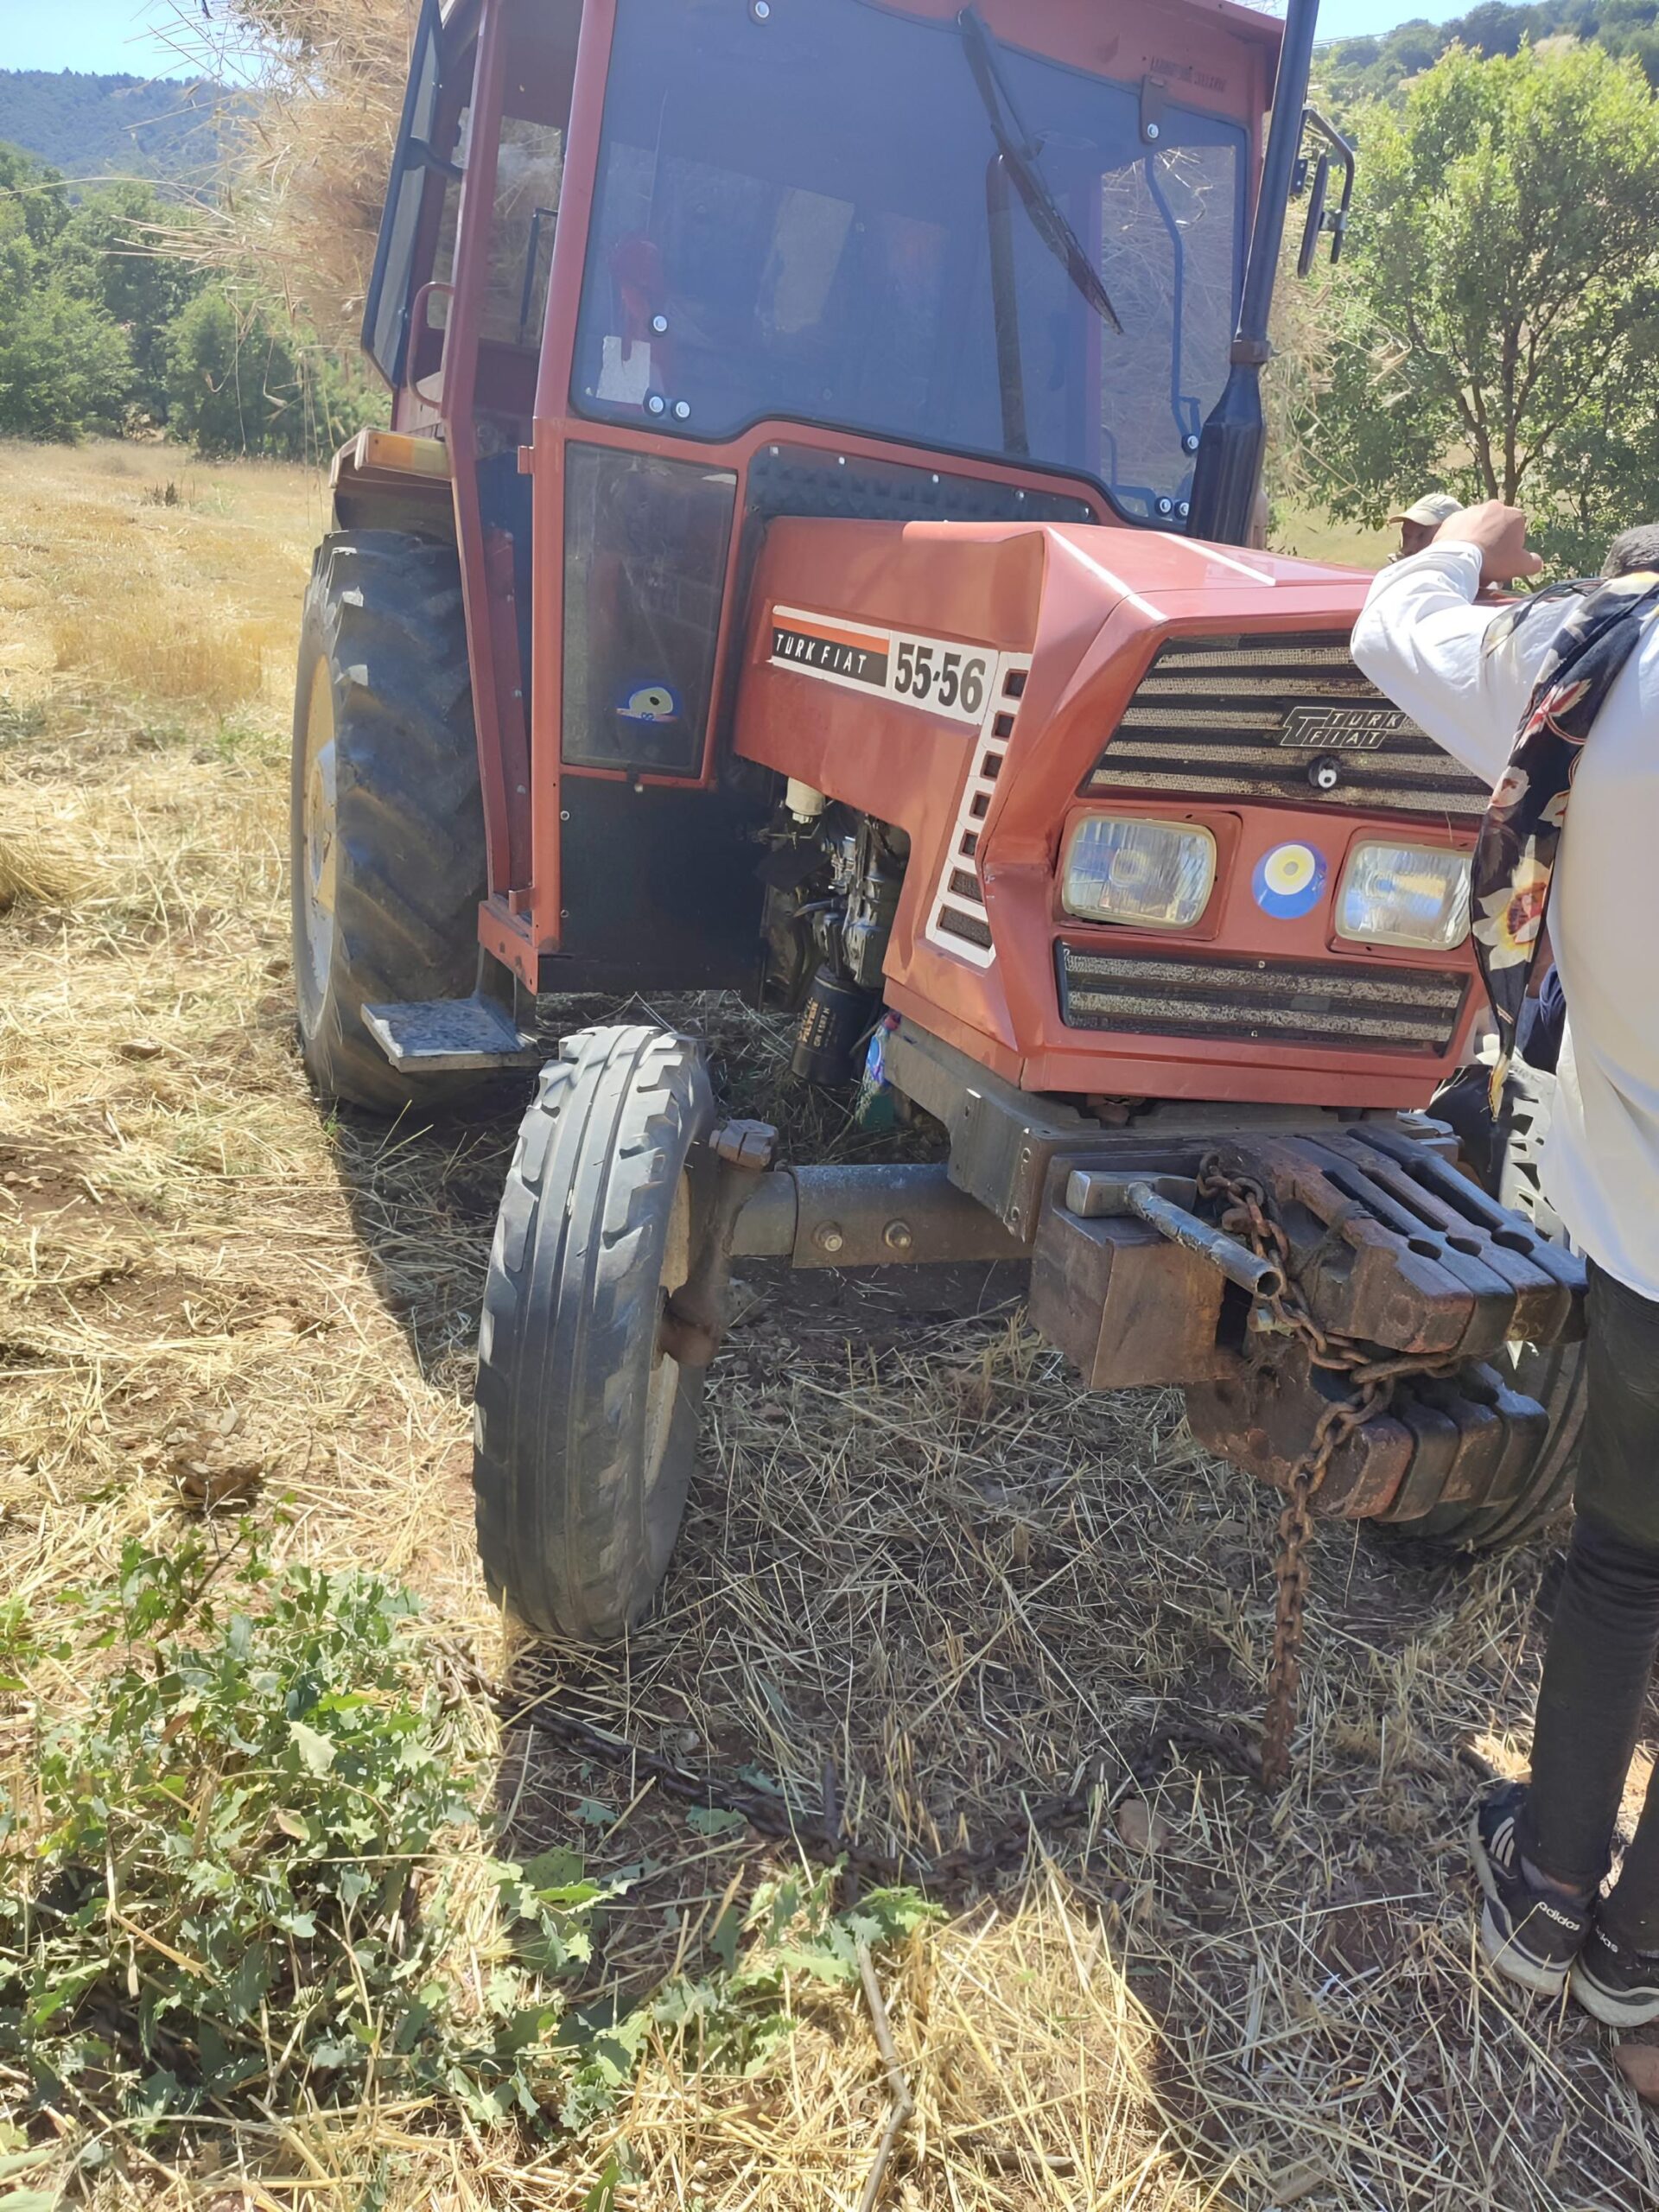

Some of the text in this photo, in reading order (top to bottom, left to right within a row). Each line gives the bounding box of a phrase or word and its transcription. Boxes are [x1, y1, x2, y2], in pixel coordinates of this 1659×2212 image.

[820, 644, 867, 675] FIAT
[1309, 731, 1380, 745] FIAT
[1538, 1901, 1580, 1930] adidas
